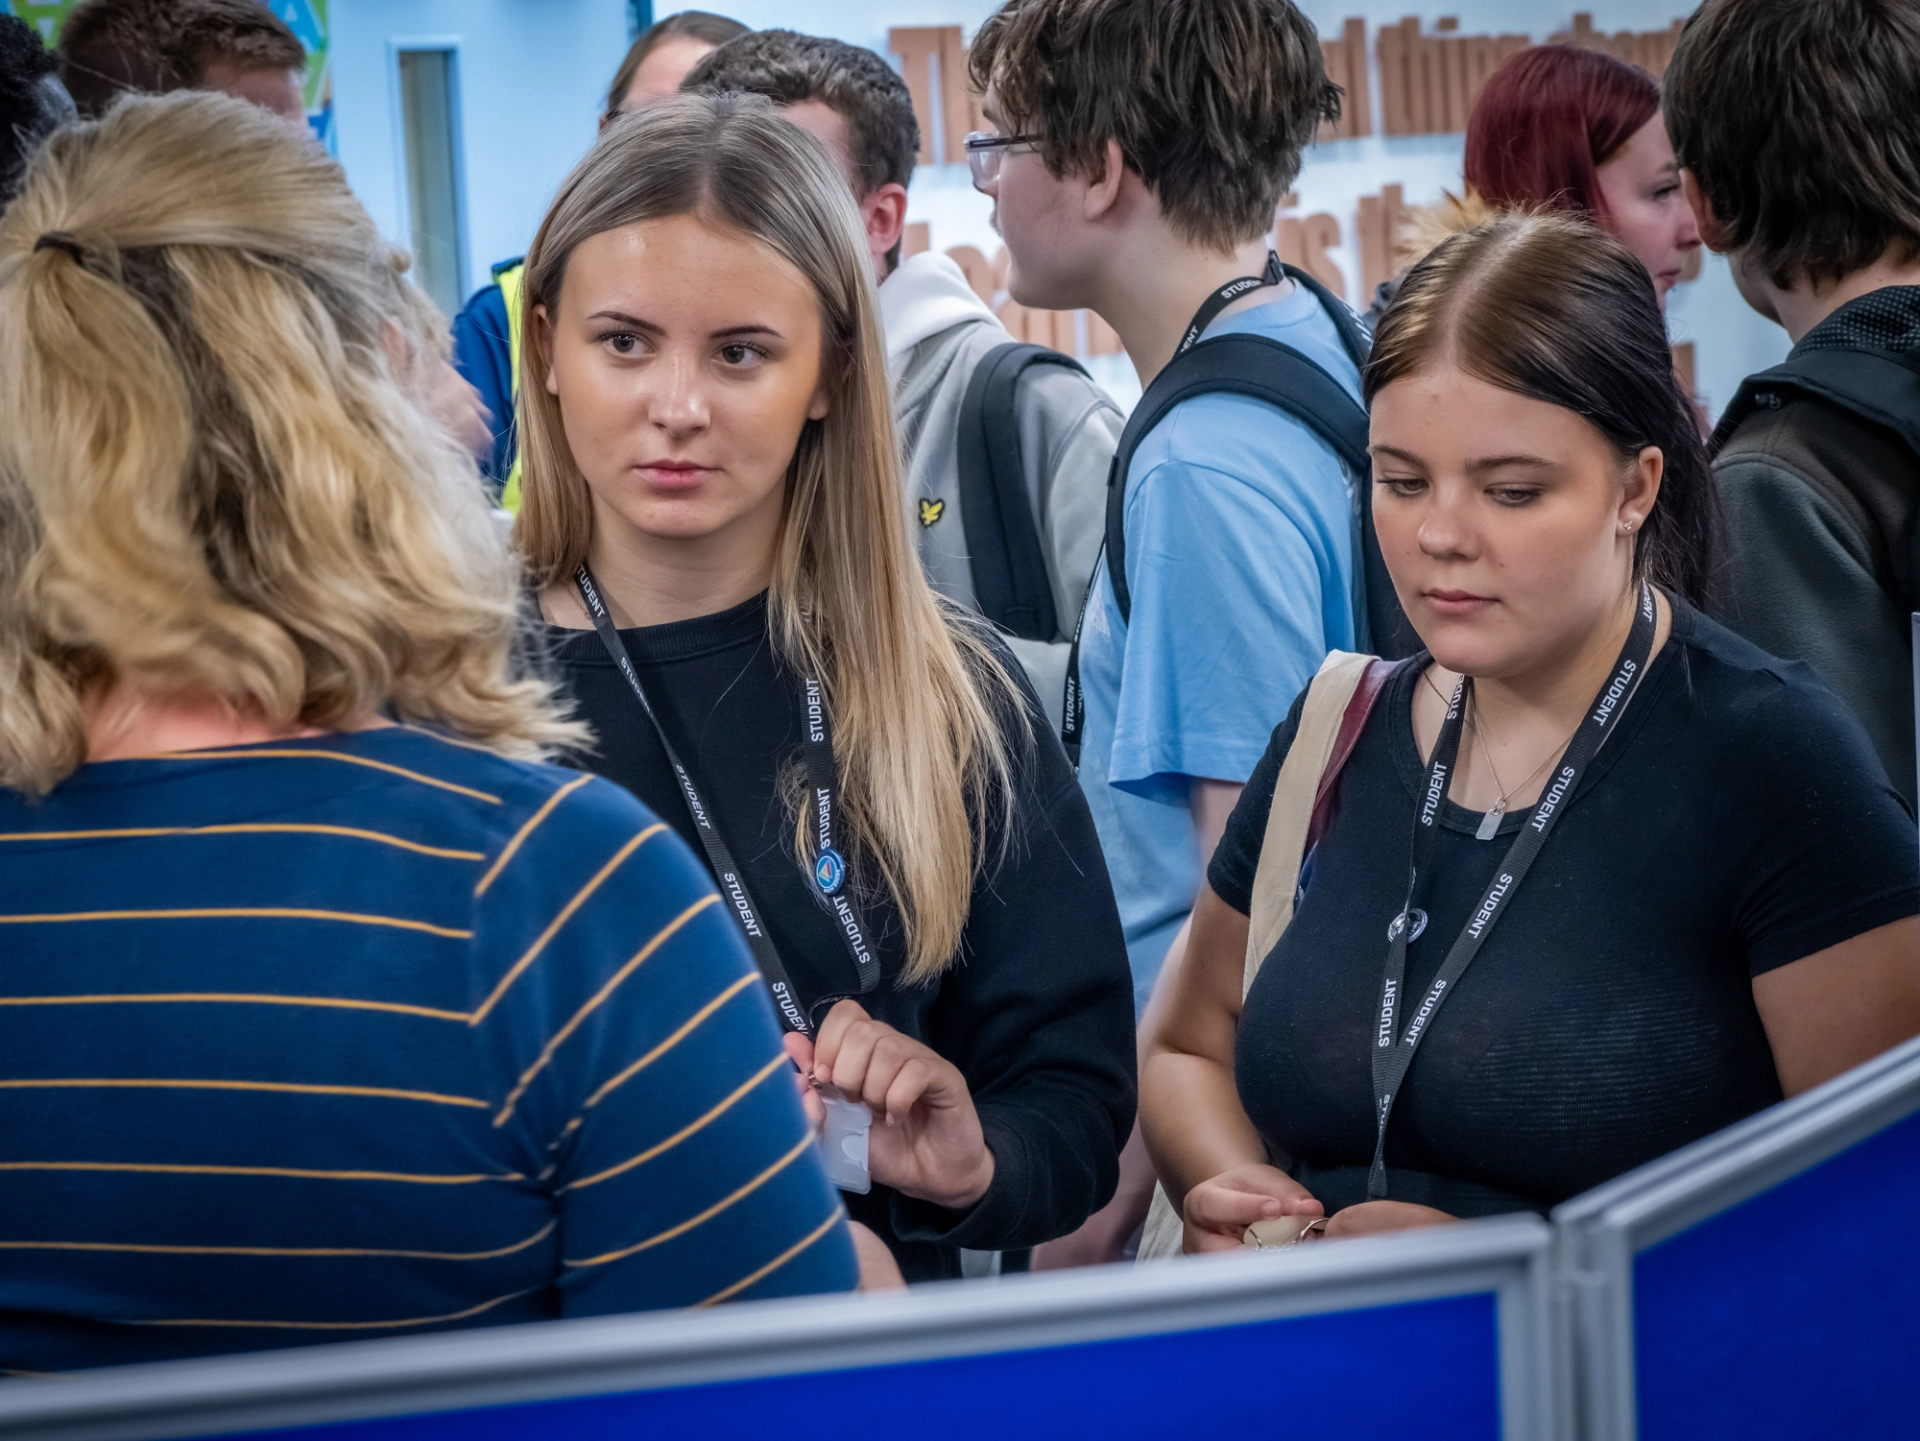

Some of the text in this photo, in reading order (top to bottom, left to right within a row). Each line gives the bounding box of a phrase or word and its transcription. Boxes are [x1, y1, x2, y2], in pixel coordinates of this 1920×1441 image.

[577, 563, 606, 618] TUDENT
[805, 677, 825, 742] STUDENT
[1065, 676, 1075, 731] STUDENT
[1446, 673, 1465, 720] STUDE
[1593, 659, 1637, 726] STUDENT
[676, 763, 711, 830] STUDENT
[816, 787, 830, 850] STUDENT
[1421, 760, 1448, 827] STUDENT
[1531, 766, 1575, 832] STUDENT
[724, 872, 762, 938] STUDENT
[833, 895, 871, 964] STUDENT
[1467, 873, 1513, 939] STUDENT
[1379, 978, 1397, 1048] STUDENT
[1405, 979, 1447, 1047] STUDENT
